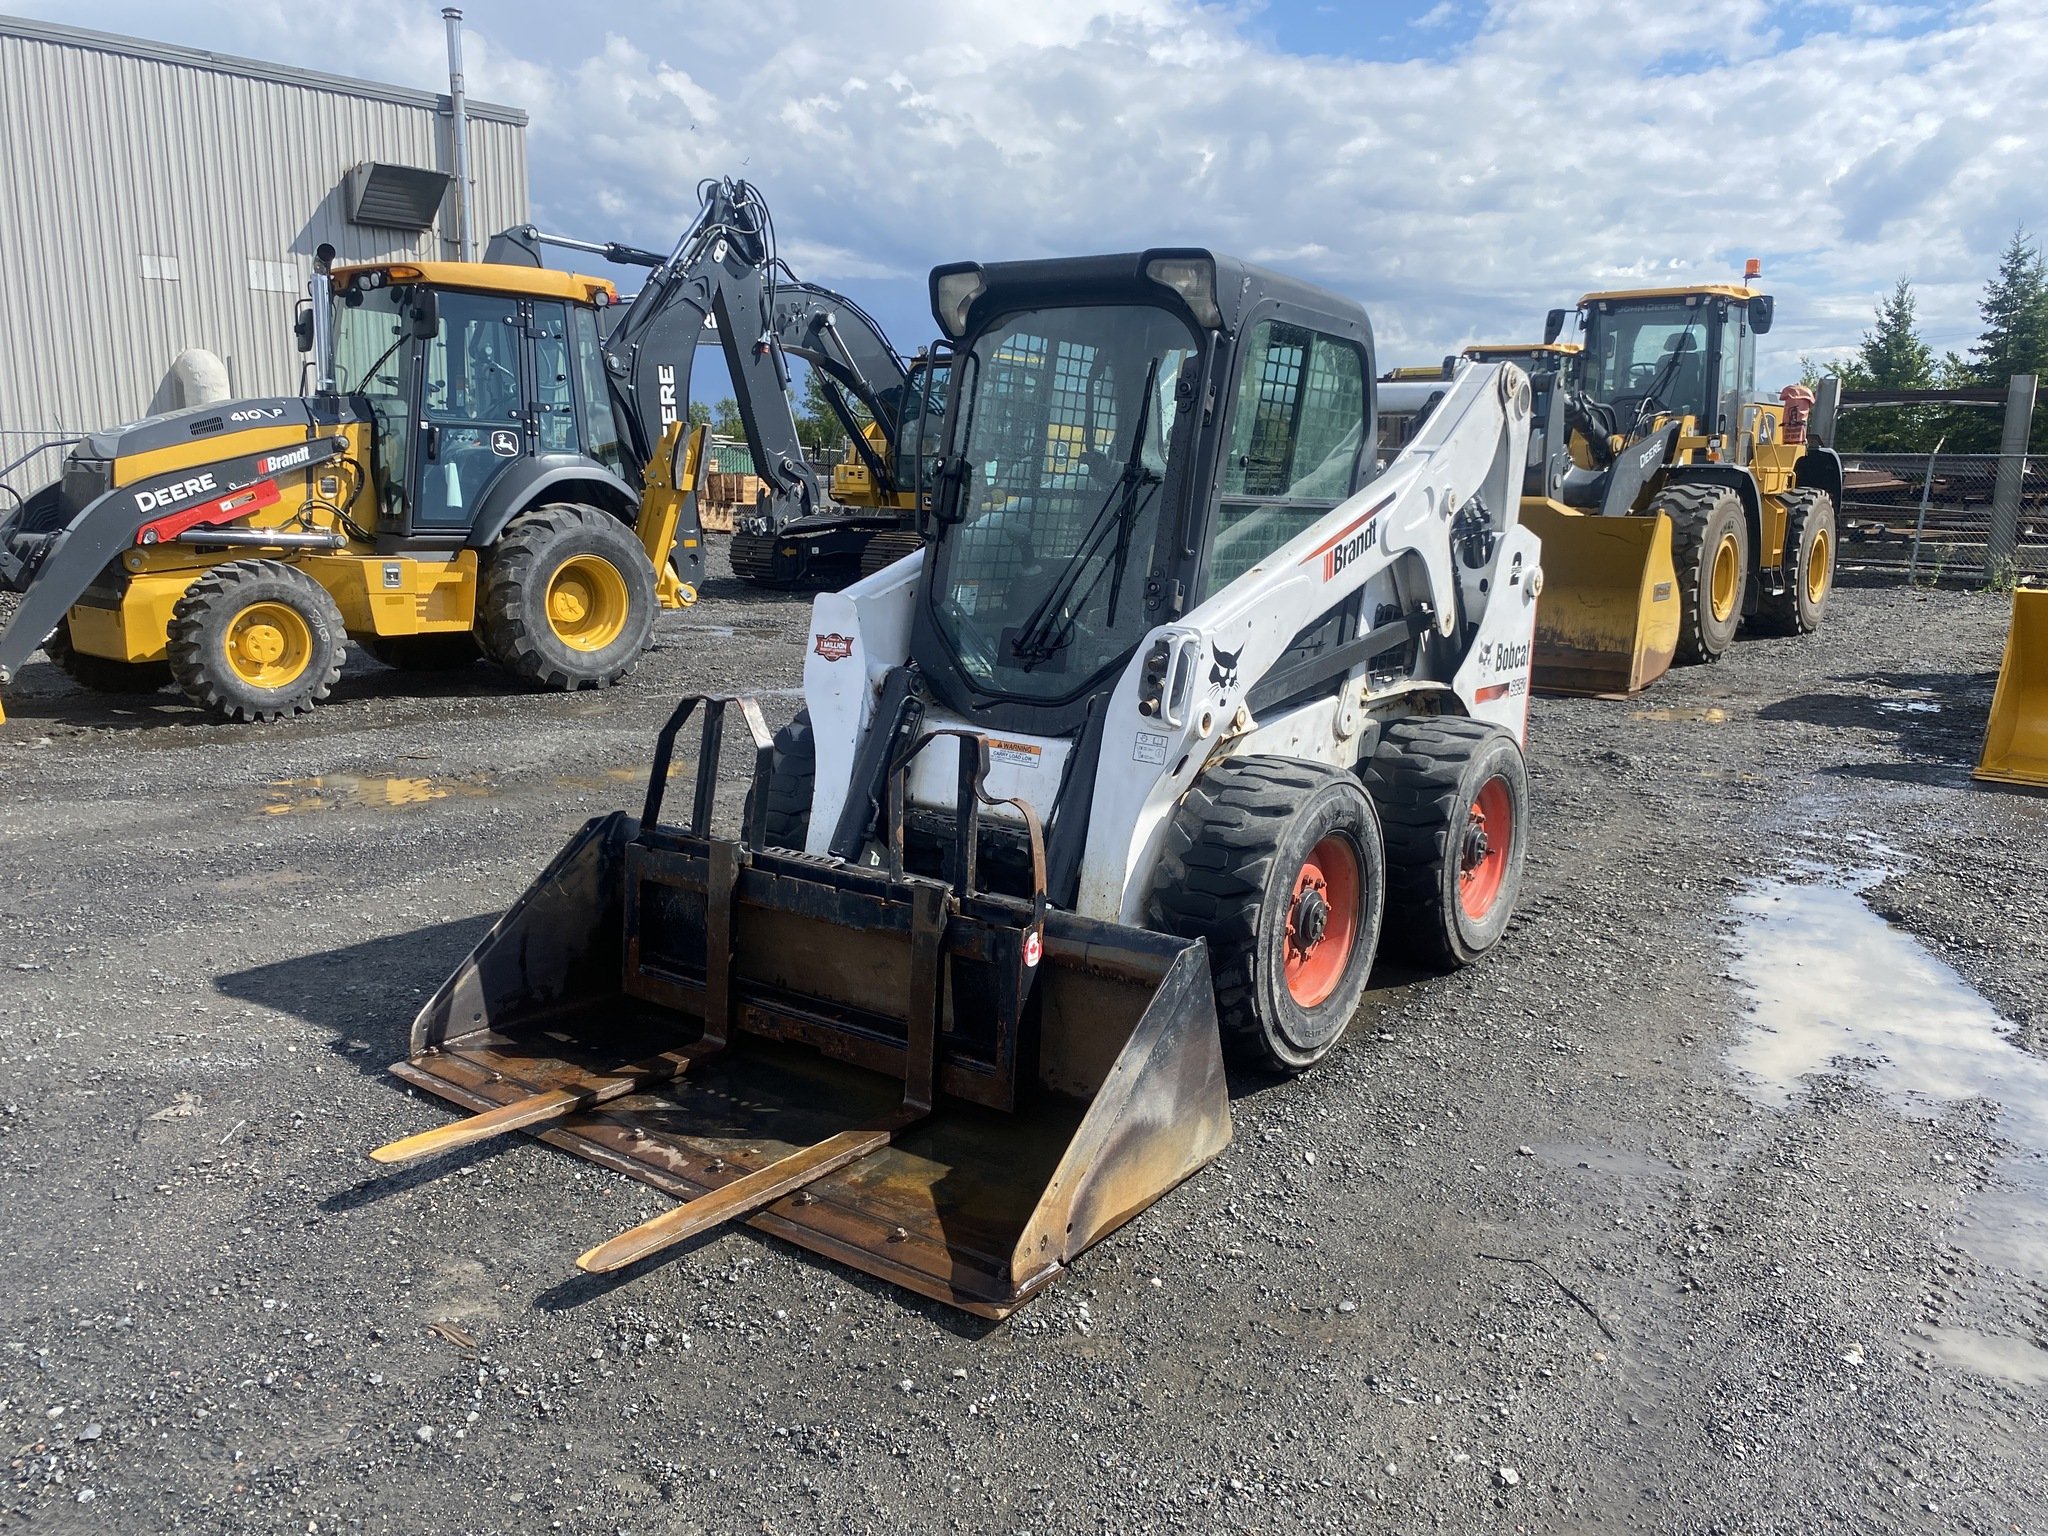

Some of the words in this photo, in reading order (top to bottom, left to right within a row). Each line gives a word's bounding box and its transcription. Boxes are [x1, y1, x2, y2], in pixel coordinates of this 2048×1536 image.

[1616, 304, 1645, 313] JOHN
[1646, 303, 1681, 312] DEERE
[230, 409, 262, 422] 410
[658, 365, 677, 438] ERE
[266, 446, 310, 473] Brandt
[1639, 439, 1663, 469] DEERE
[134, 472, 218, 513] DEERE
[1333, 517, 1377, 577] Brandt
[1495, 639, 1531, 673] Bobcat
[1004, 743, 1032, 753] WARNING
